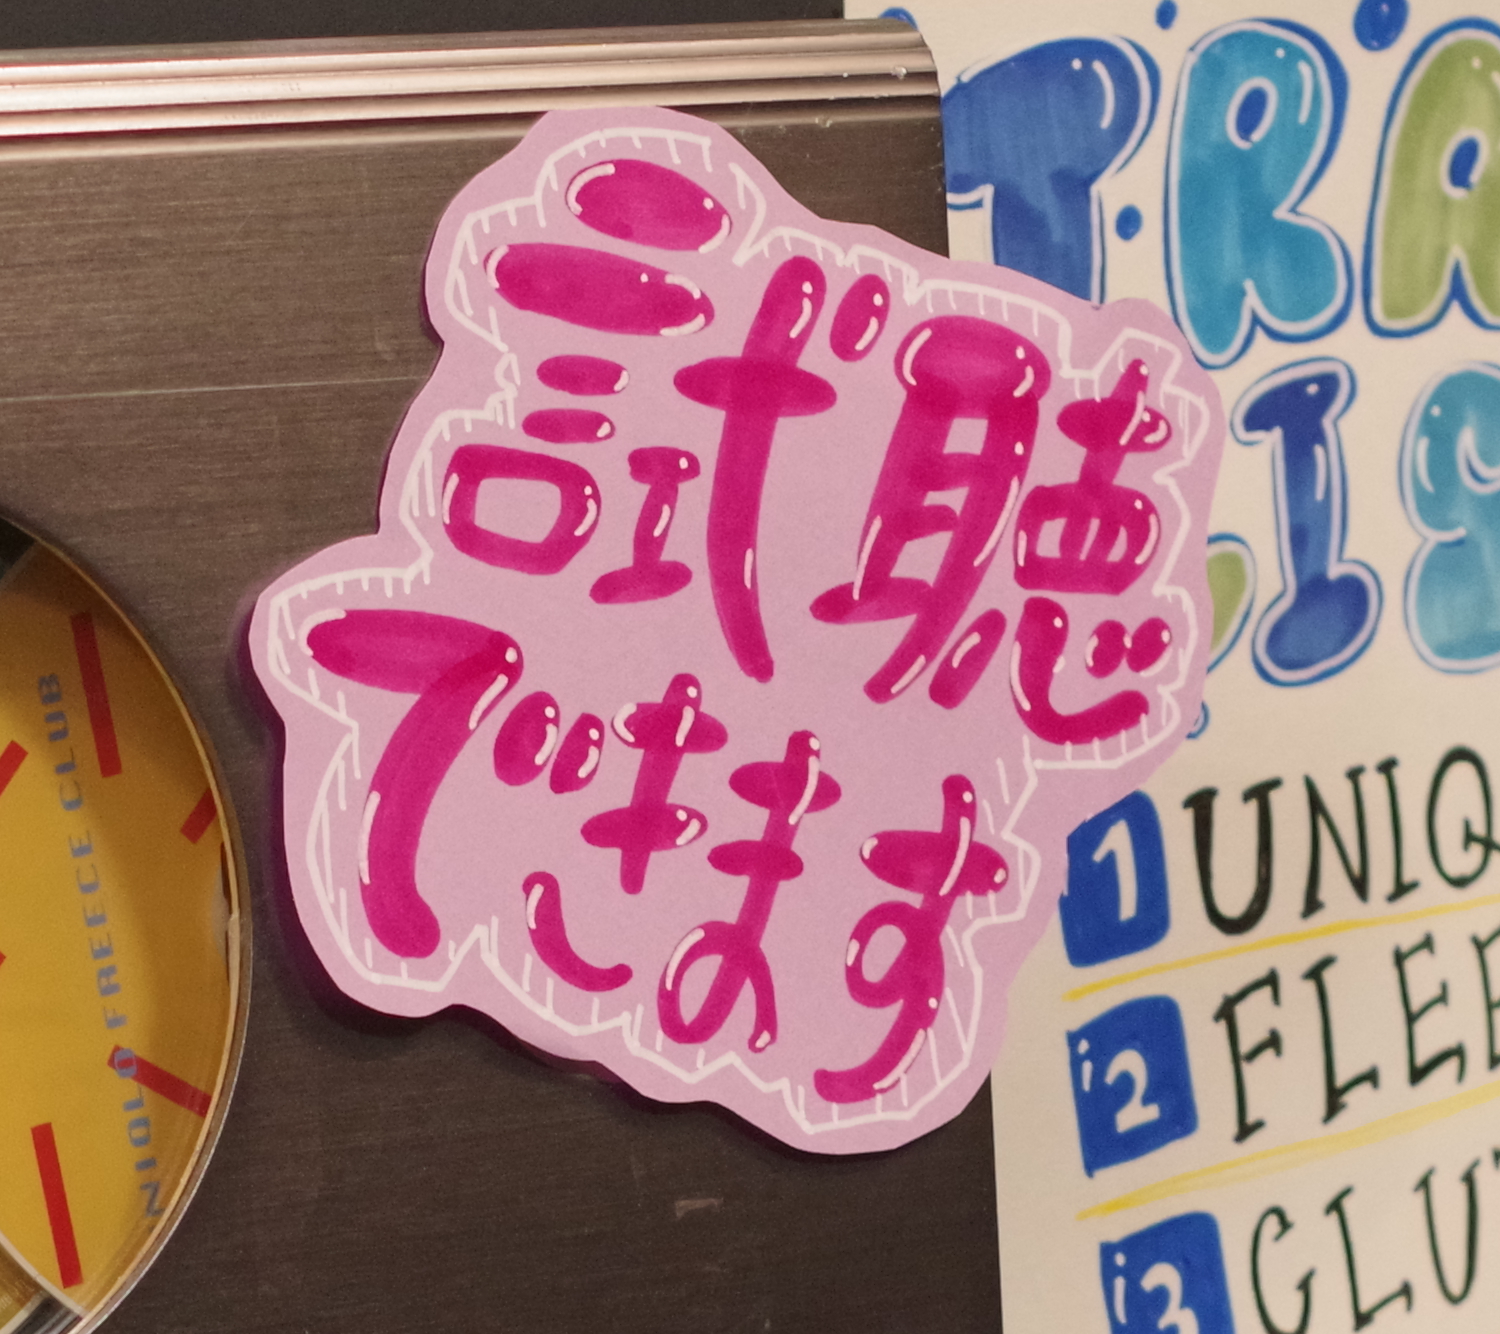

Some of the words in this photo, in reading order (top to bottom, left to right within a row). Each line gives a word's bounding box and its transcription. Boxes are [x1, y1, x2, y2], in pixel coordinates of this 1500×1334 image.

[441, 157, 1173, 746] 試聴
[37, 671, 85, 812] CLUB
[304, 607, 1011, 1104] できます
[1088, 817, 1142, 925] 1
[1101, 1049, 1162, 1134] 2
